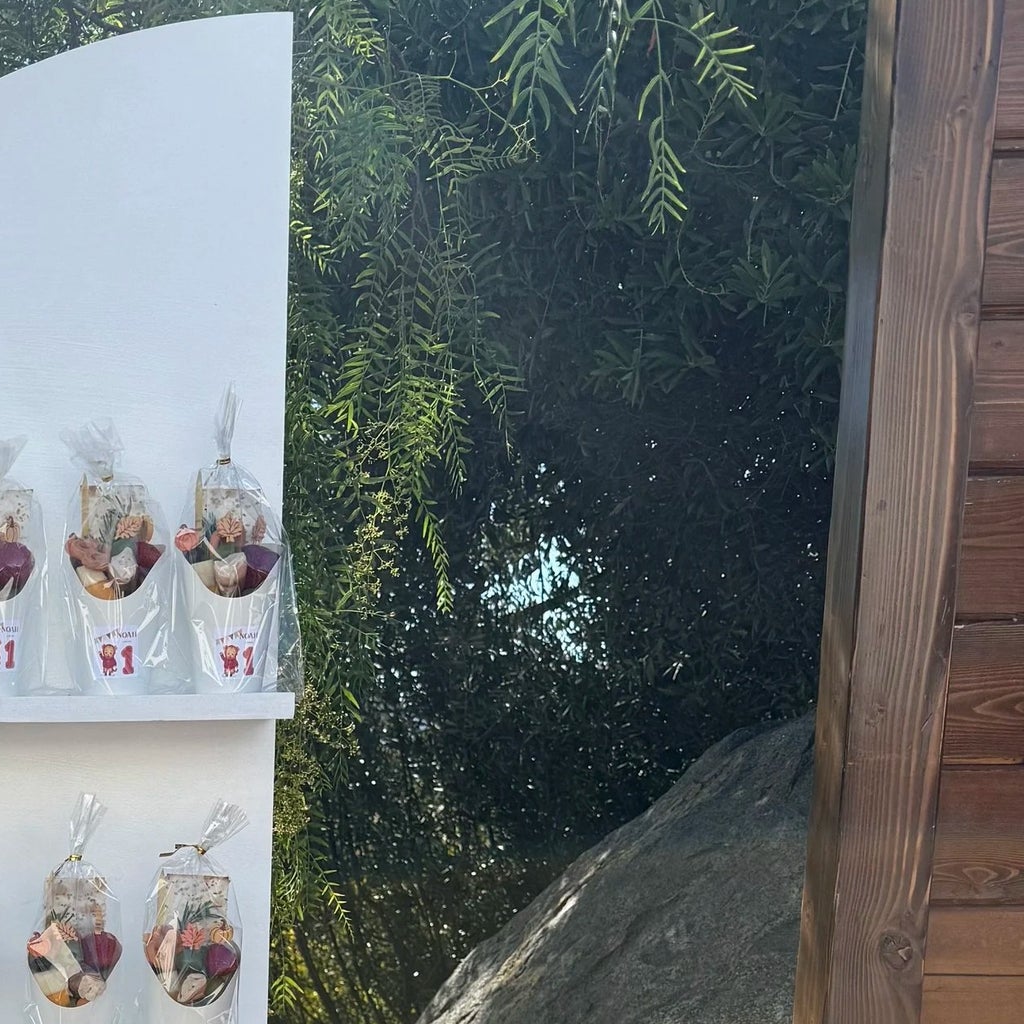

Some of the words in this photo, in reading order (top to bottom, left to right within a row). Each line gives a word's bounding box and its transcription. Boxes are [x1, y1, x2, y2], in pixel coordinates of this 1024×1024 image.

[116, 631, 137, 639] NOAH
[4, 639, 15, 669] 1
[121, 645, 134, 675] 1
[243, 646, 254, 676] 1
